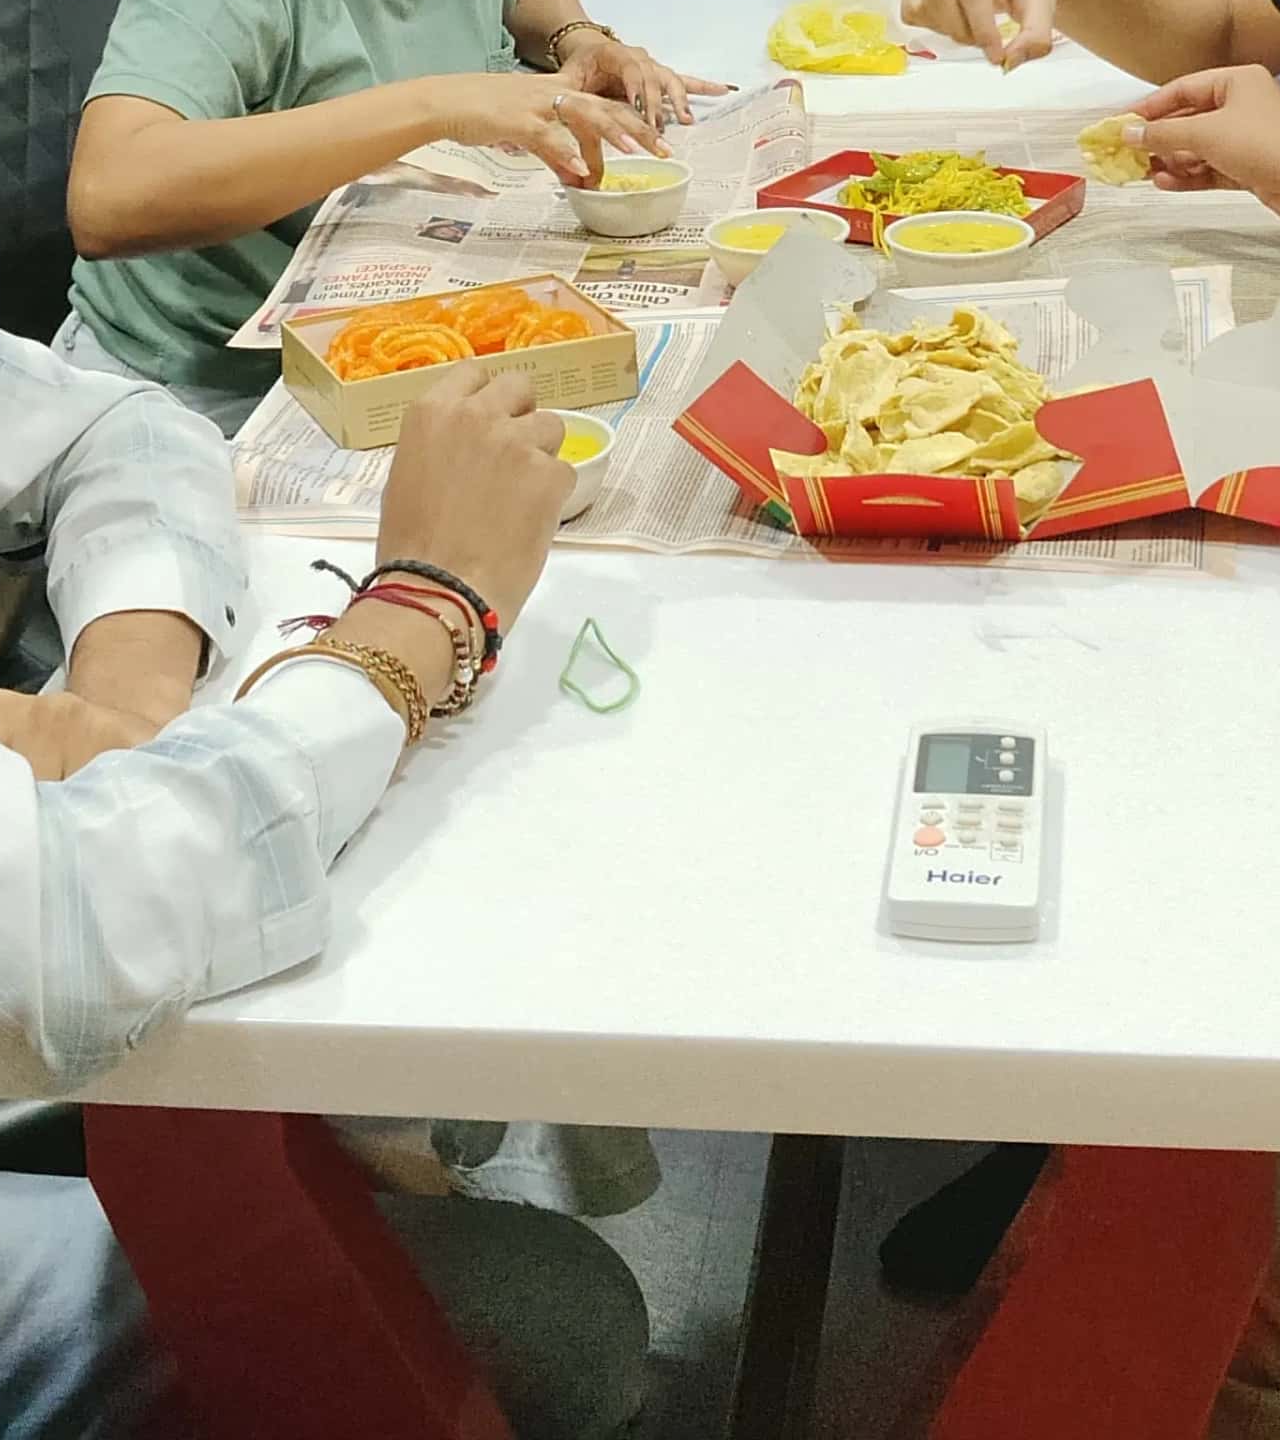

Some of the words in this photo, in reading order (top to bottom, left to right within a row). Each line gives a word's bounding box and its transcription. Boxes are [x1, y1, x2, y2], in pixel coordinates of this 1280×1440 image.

[605, 282, 689, 296] Fertiliser
[618, 292, 670, 304] China
[927, 869, 1003, 886] Haier
